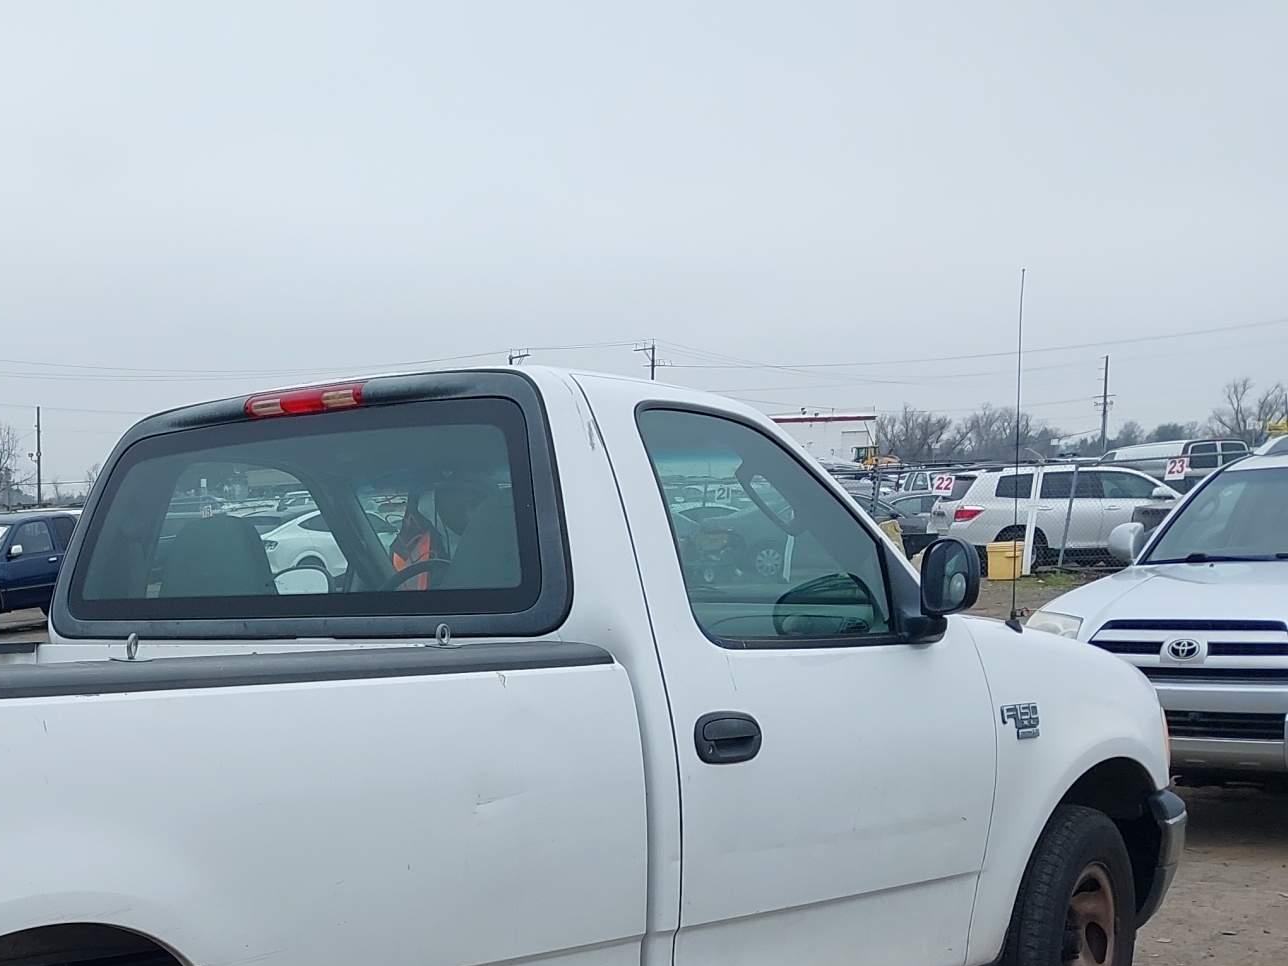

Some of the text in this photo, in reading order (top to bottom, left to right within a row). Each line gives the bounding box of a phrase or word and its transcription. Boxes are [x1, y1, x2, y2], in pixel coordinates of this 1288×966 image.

[1168, 459, 1185, 475] 23
[935, 476, 953, 491] 22
[716, 487, 730, 500] 21
